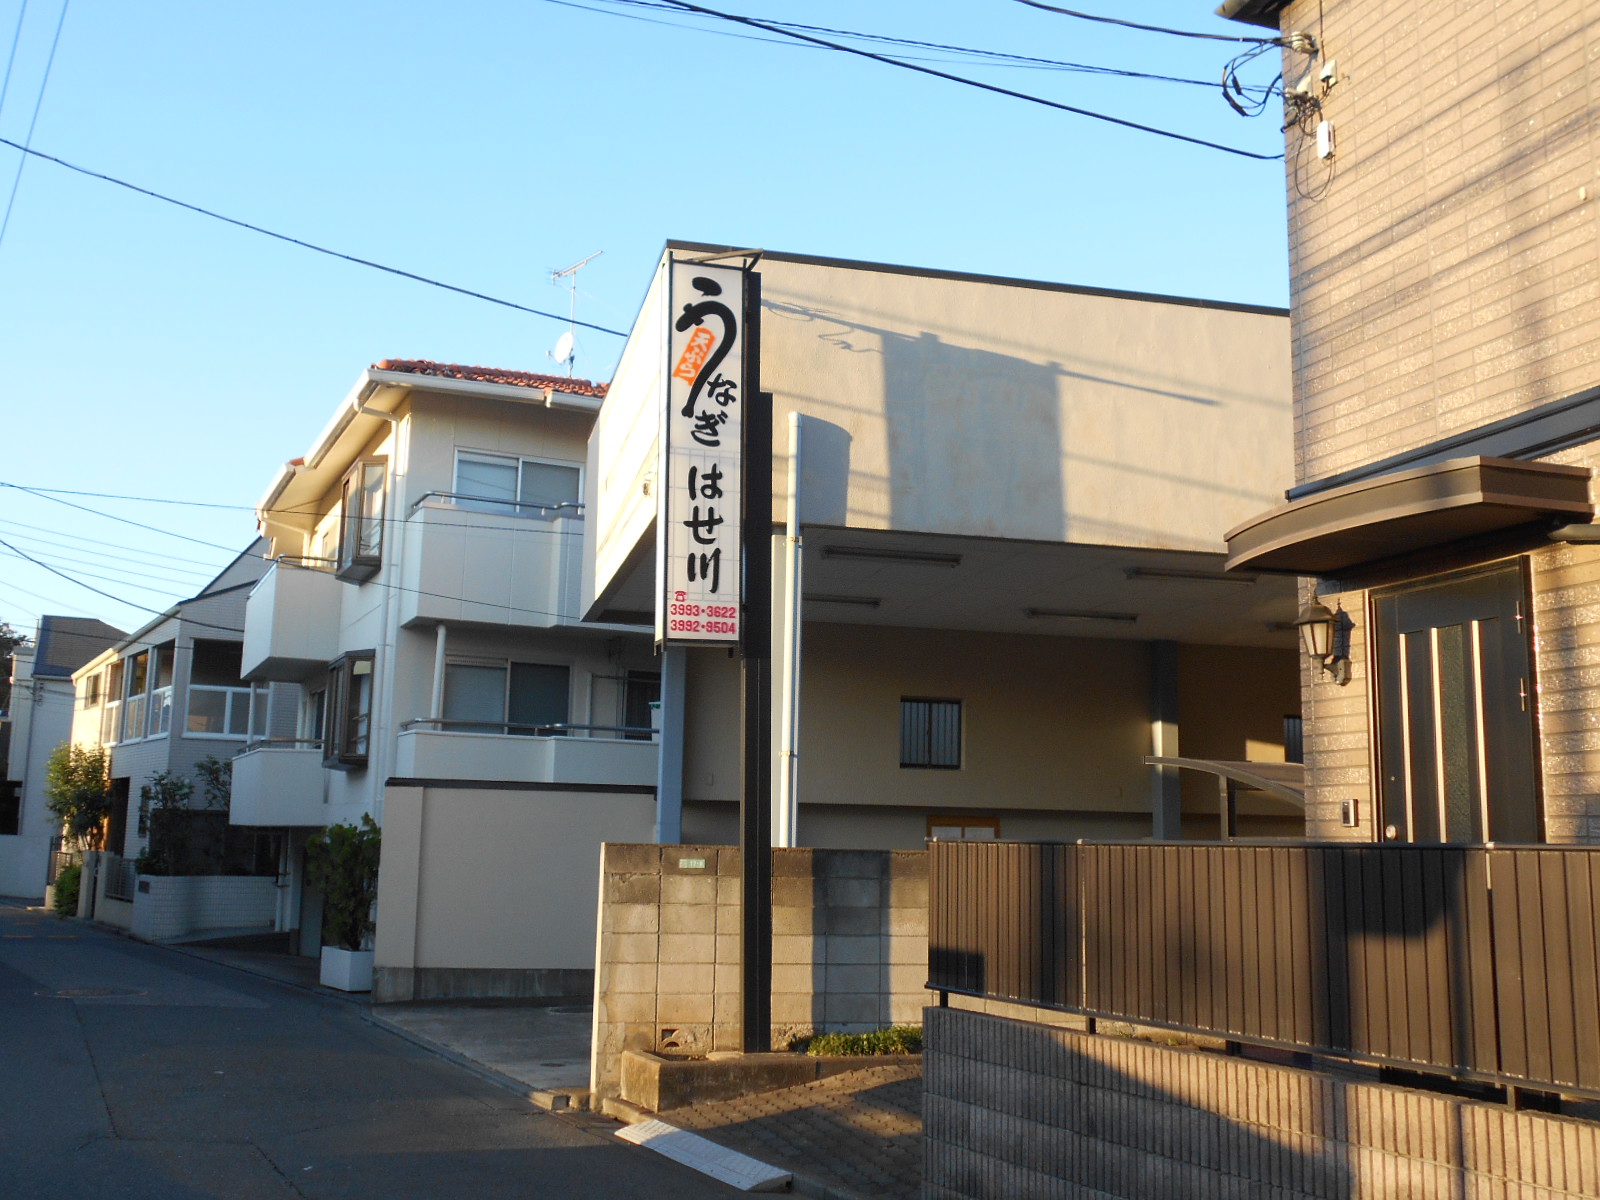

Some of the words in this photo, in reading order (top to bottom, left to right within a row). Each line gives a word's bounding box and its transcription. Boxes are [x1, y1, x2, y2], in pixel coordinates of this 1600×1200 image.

[675, 276, 738, 447] うなぎ
[678, 331, 711, 378] 天ぷら
[683, 463, 724, 594] はせ川
